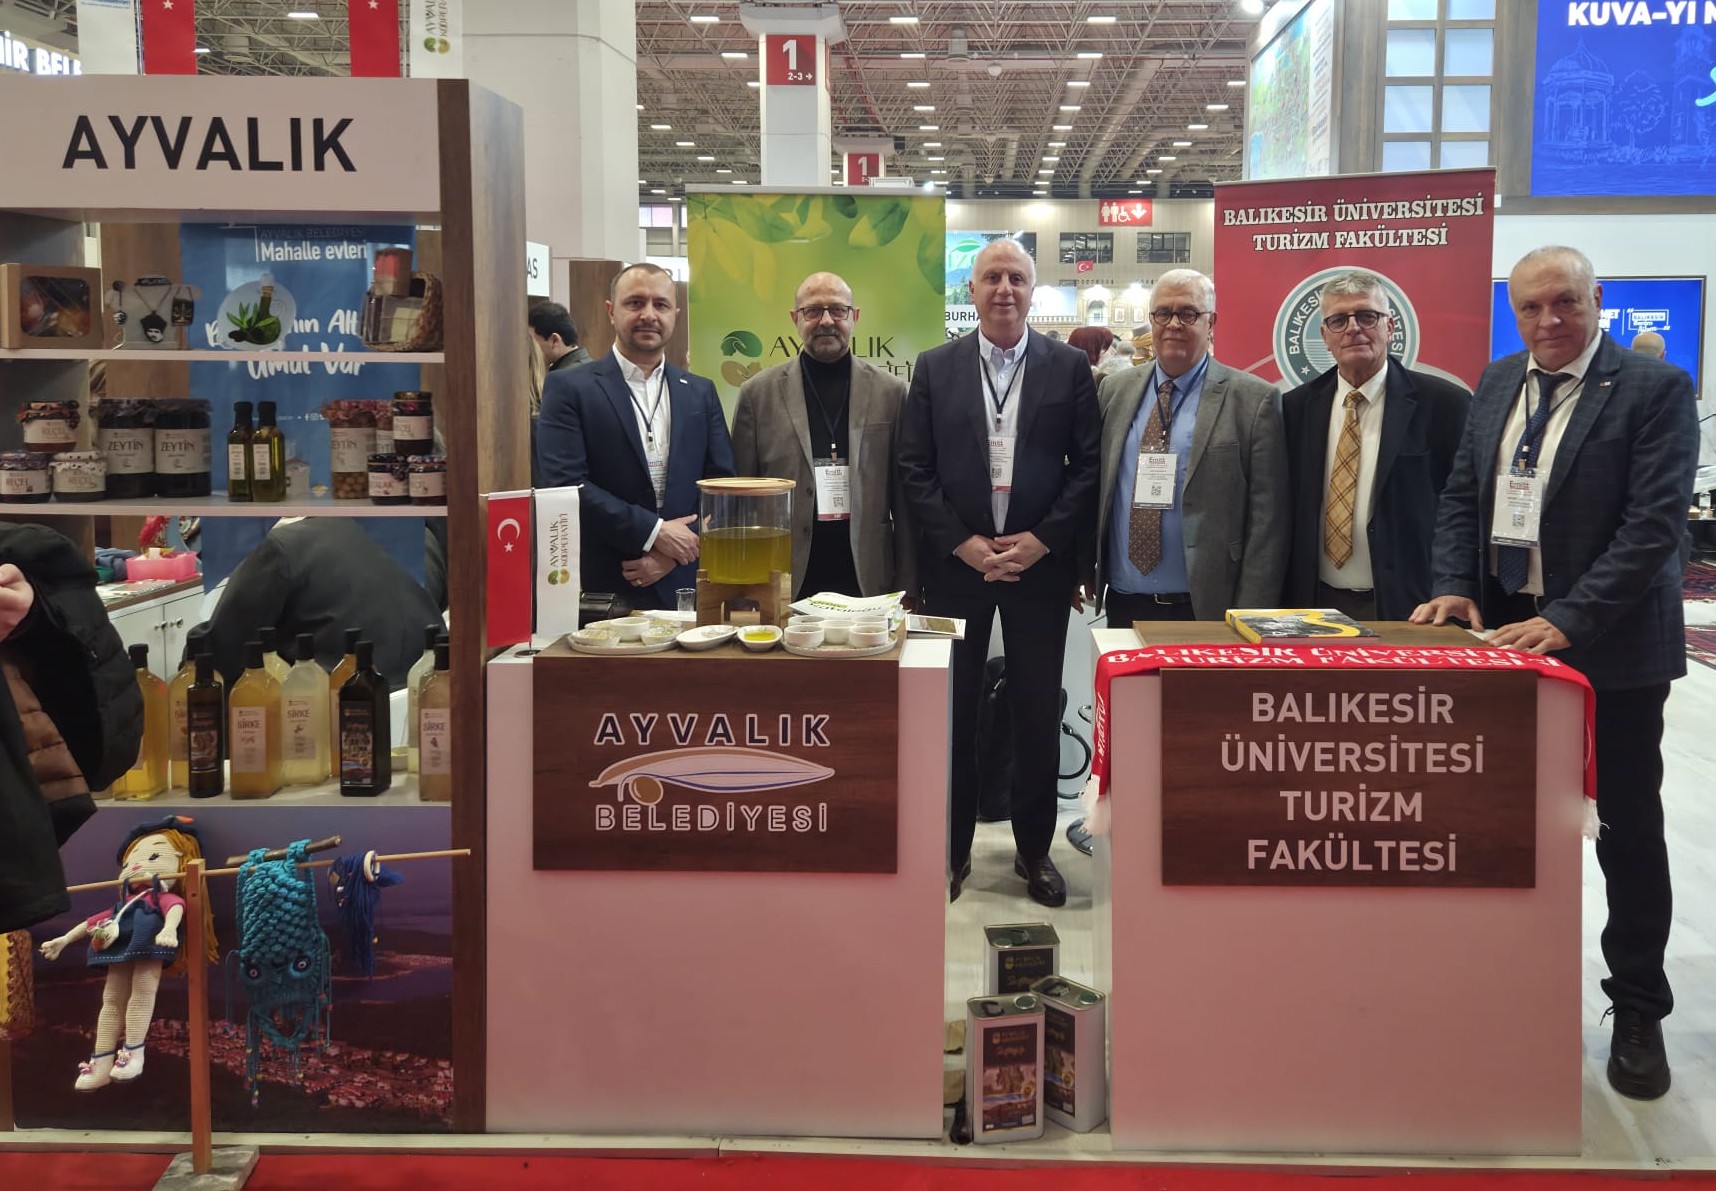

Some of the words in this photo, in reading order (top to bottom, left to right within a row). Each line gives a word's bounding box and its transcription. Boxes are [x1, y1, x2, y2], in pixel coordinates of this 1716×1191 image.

[1568, 1, 1696, 26] KUVA-YI
[782, 39, 797, 70] 1
[788, 72, 803, 81] 2-3
[62, 115, 357, 172] AYVALIK
[857, 156, 868, 176] 1
[1223, 201, 1328, 226] BALIKESİR
[1333, 192, 1484, 221] ÜNİVERSİTESİ
[261, 240, 321, 262] Mahalle
[325, 239, 367, 260] evleri
[1253, 228, 1329, 251] TURİZM
[1335, 222, 1448, 248] FAKÜLTESİ
[769, 336, 895, 358] AYLIK
[107, 438, 144, 451] ZEYTİN
[160, 439, 196, 452] ZEYTİN
[549, 519, 559, 568] AYVALIK
[287, 708, 311, 718] SİRKE
[1252, 686, 1454, 724] BALIKESİR
[237, 718, 260, 729] SİRKE
[423, 720, 447, 732] SİRKE
[594, 713, 831, 747] AYVALIK
[1221, 733, 1484, 774] ÜNİVERSİTESİ
[595, 802, 828, 832] BELEDİYESİ
[1279, 783, 1423, 822] TURİZM
[1247, 832, 1457, 872] FAKÜLTESİ
